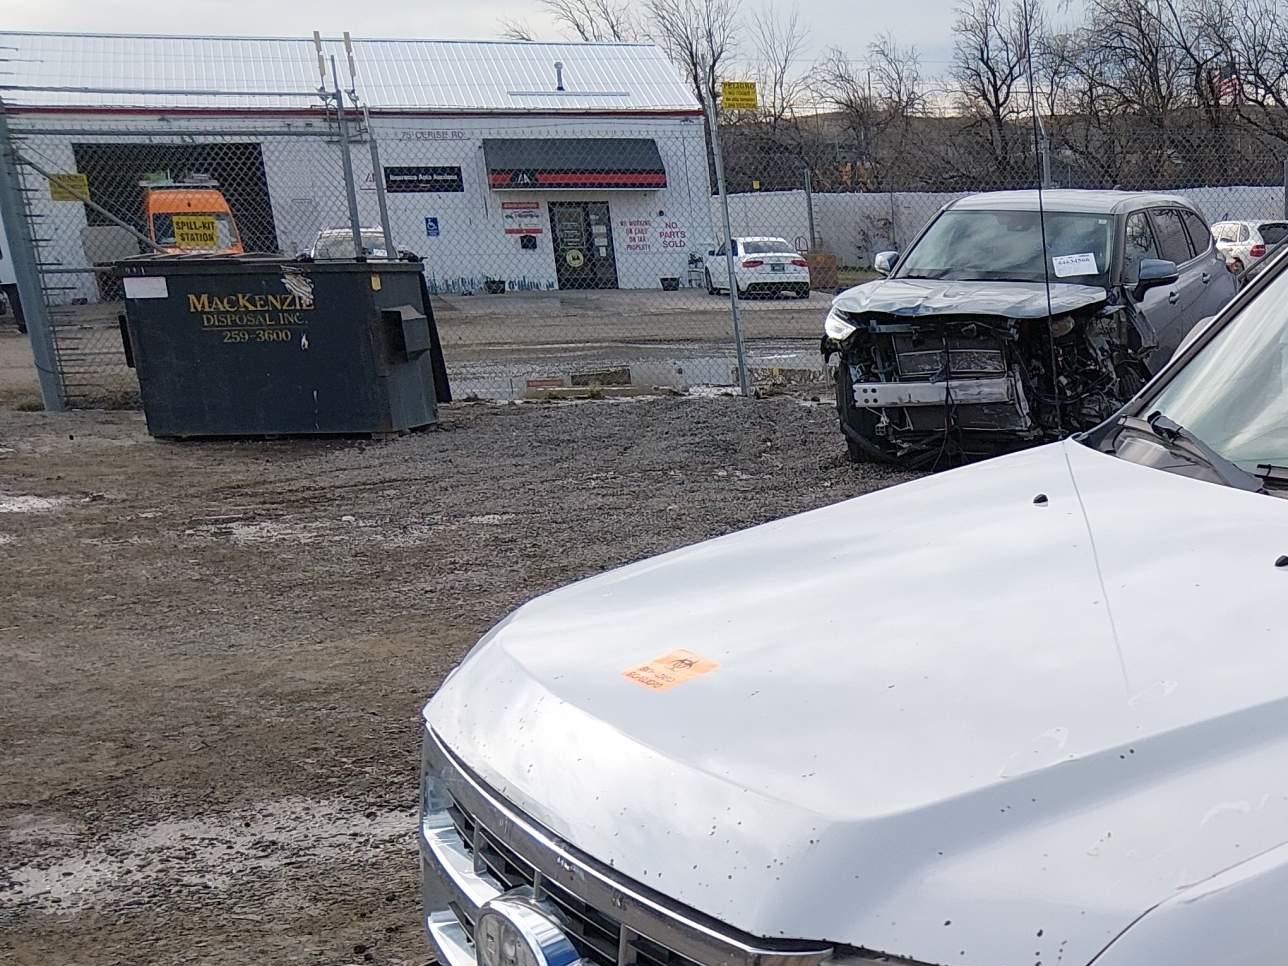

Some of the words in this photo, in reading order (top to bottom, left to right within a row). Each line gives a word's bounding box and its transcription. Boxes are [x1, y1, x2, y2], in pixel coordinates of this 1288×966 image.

[175, 221, 215, 230] SPILL-KIT
[180, 232, 214, 242] STATION
[660, 231, 686, 239] PARTS
[662, 240, 686, 248] SOLD
[224, 329, 292, 343] 259-3600
